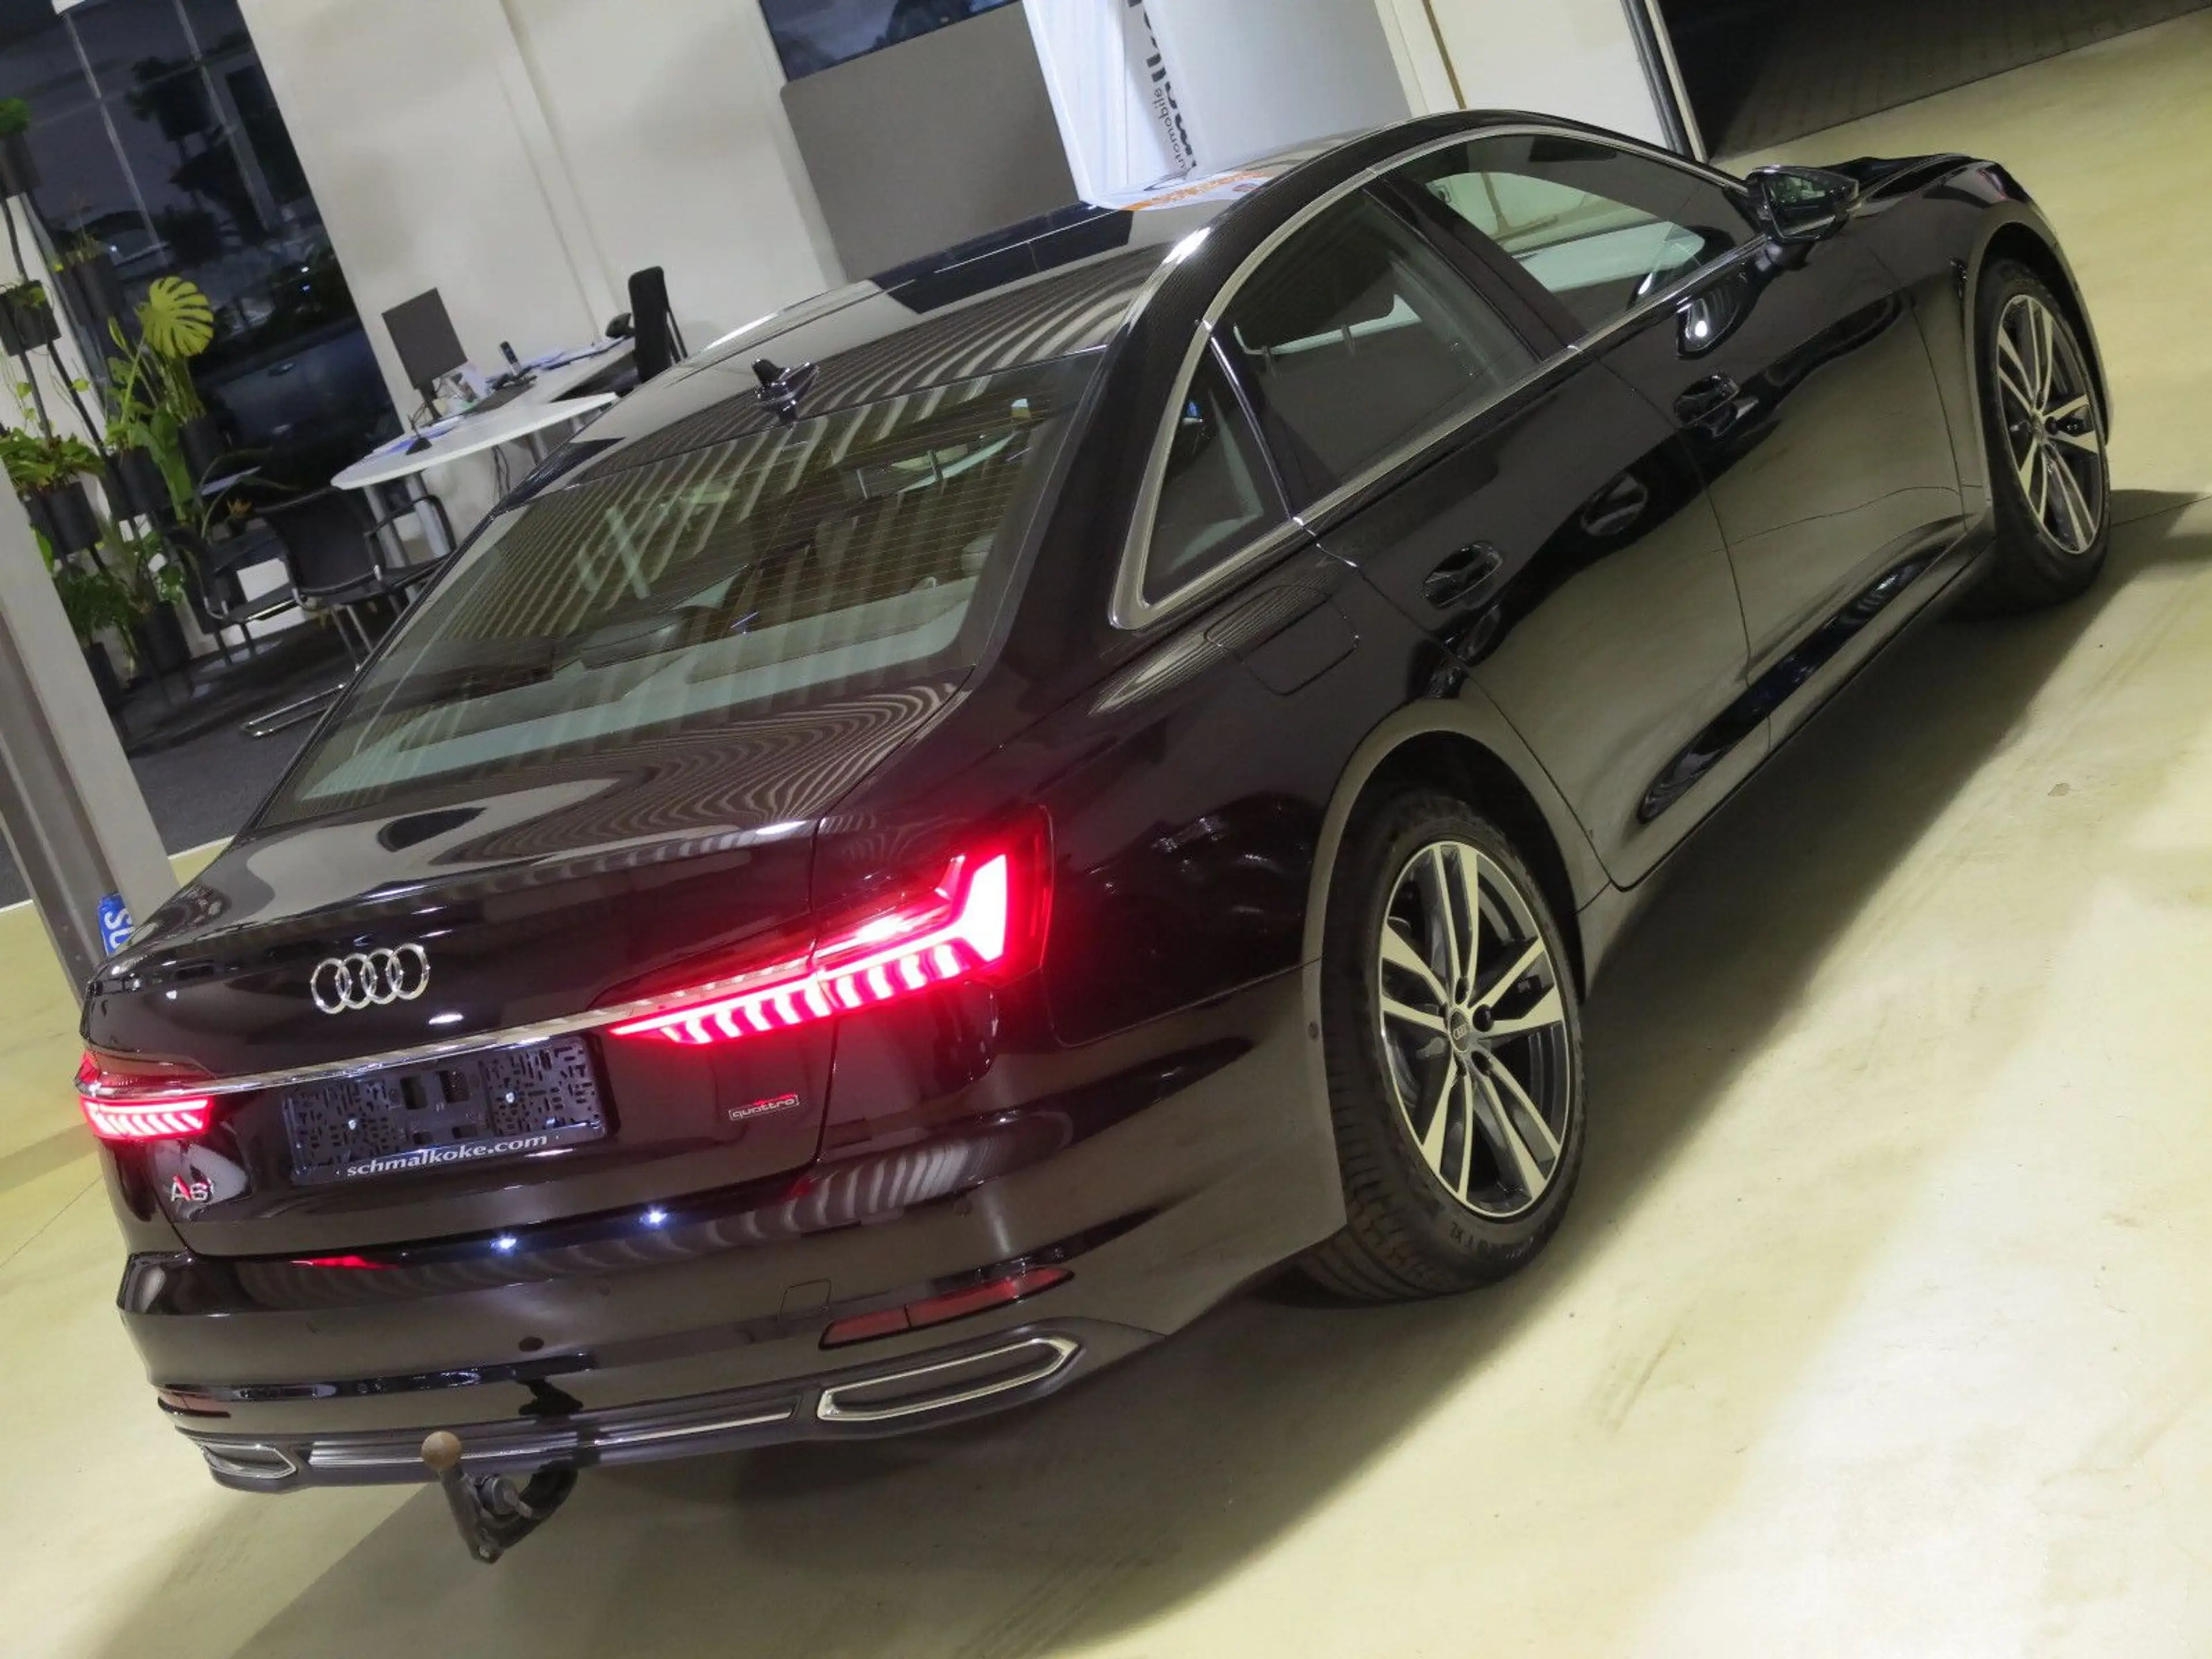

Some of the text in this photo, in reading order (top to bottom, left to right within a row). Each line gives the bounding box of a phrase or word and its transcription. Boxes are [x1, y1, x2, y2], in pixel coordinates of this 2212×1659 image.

[1153, 87, 1188, 173] utomobile
[732, 1097, 795, 1119] quattro
[346, 1134, 547, 1176] schmalkoke.com
[171, 1173, 209, 1202] A6
